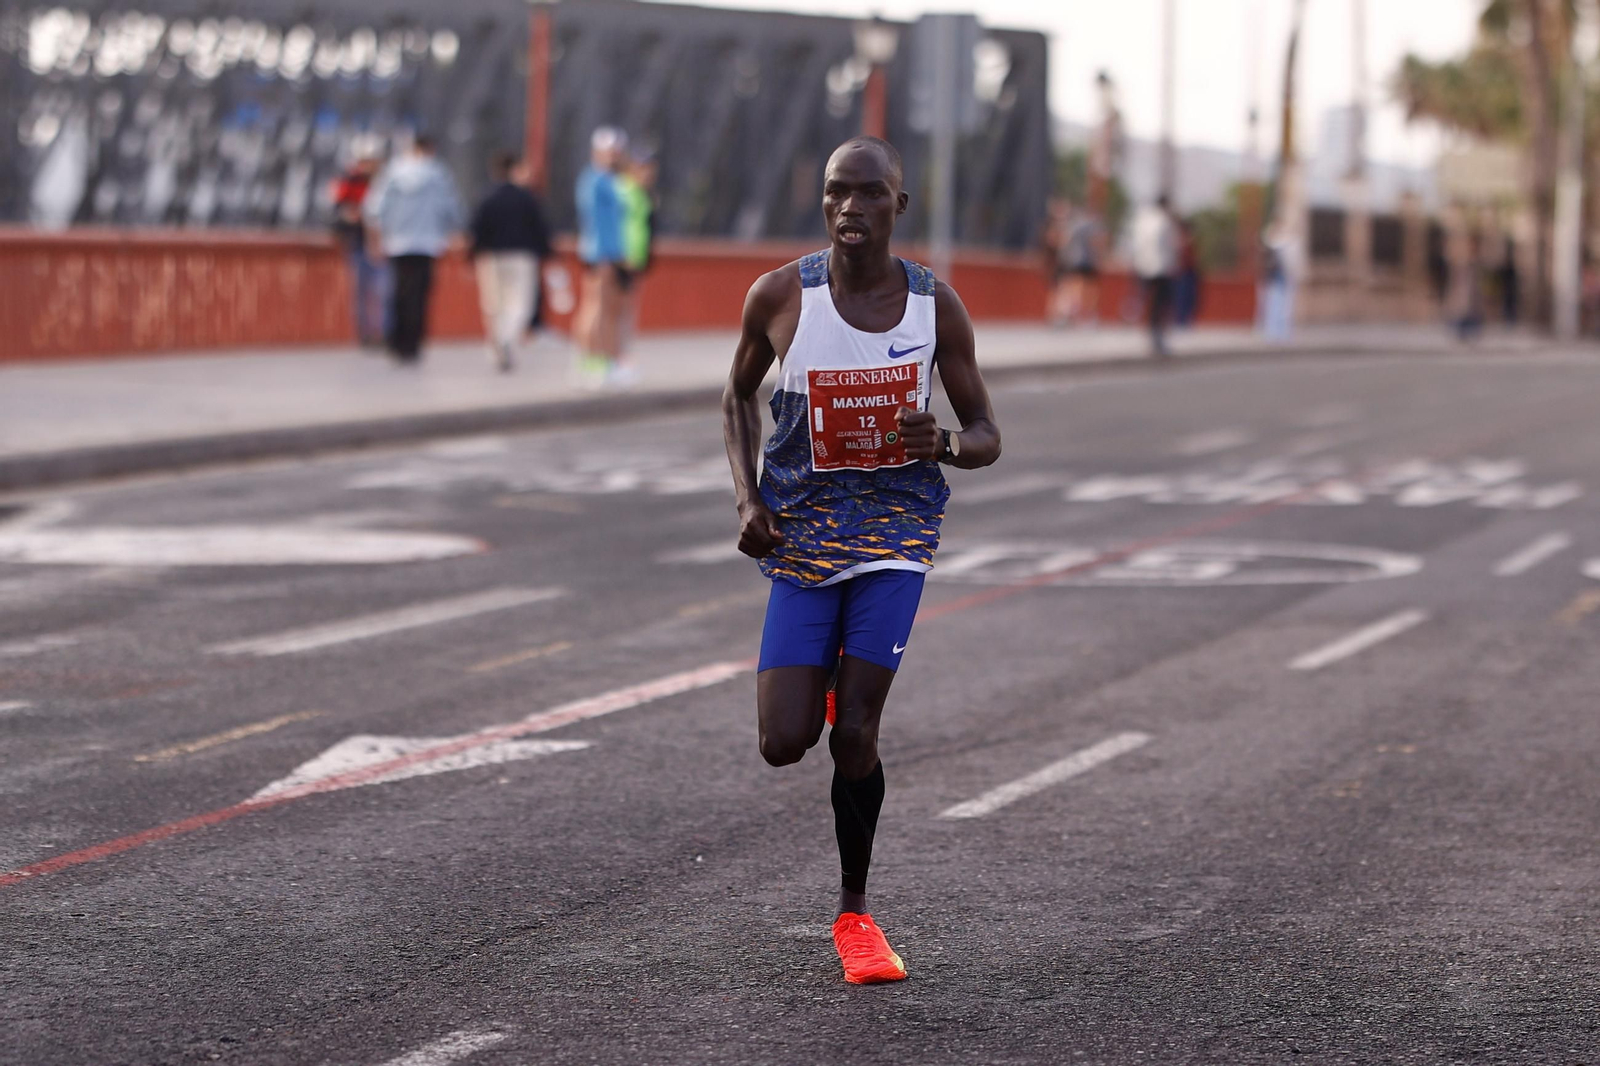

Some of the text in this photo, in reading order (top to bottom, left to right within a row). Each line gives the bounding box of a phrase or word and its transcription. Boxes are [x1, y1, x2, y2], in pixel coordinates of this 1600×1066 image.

[838, 366, 911, 386] GENERALI
[833, 394, 899, 409] MAXWELL
[858, 416, 876, 428] 12
